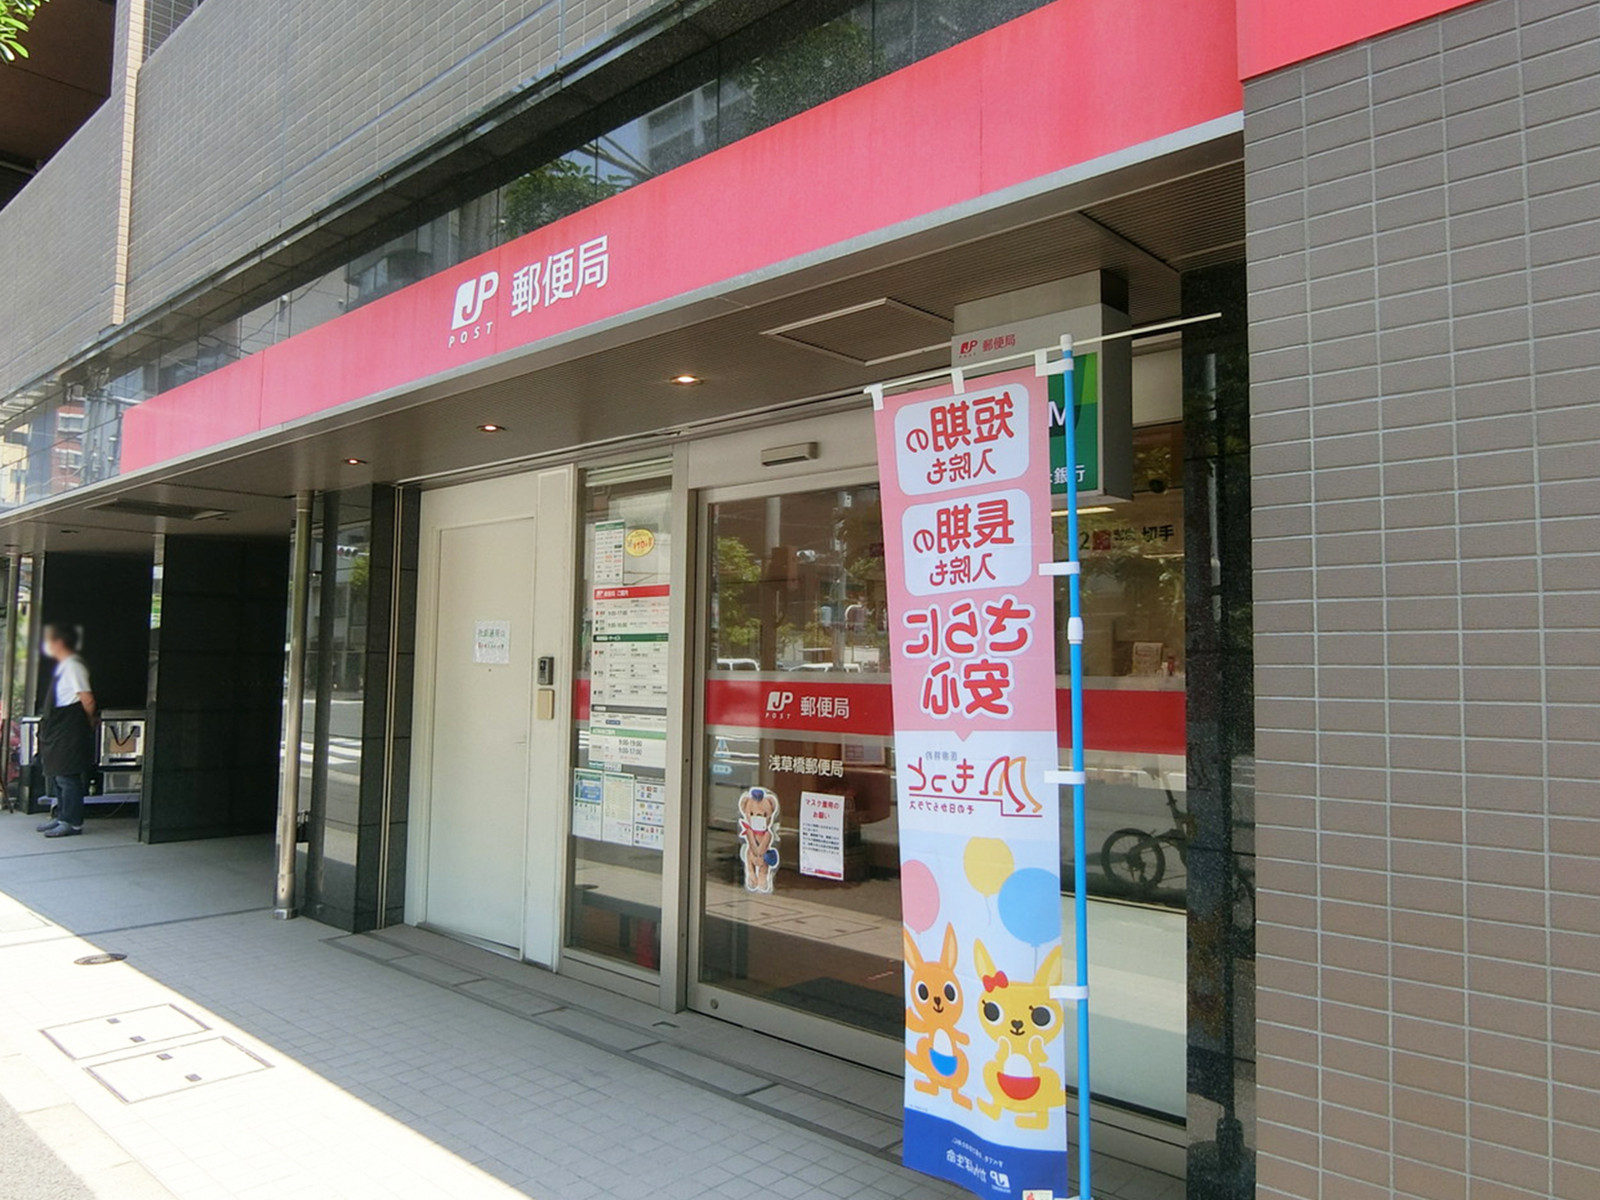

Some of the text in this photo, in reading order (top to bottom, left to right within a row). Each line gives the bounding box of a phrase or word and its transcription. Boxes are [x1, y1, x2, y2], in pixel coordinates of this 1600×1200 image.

[511, 235, 609, 317] 郵便局
[448, 321, 494, 348] POST
[982, 334, 1016, 352] 郵便局
[1142, 524, 1175, 542] 切手
[765, 711, 791, 720] POST
[800, 696, 850, 719] 郵便局
[769, 754, 844, 779] 浅草橋郵便局
